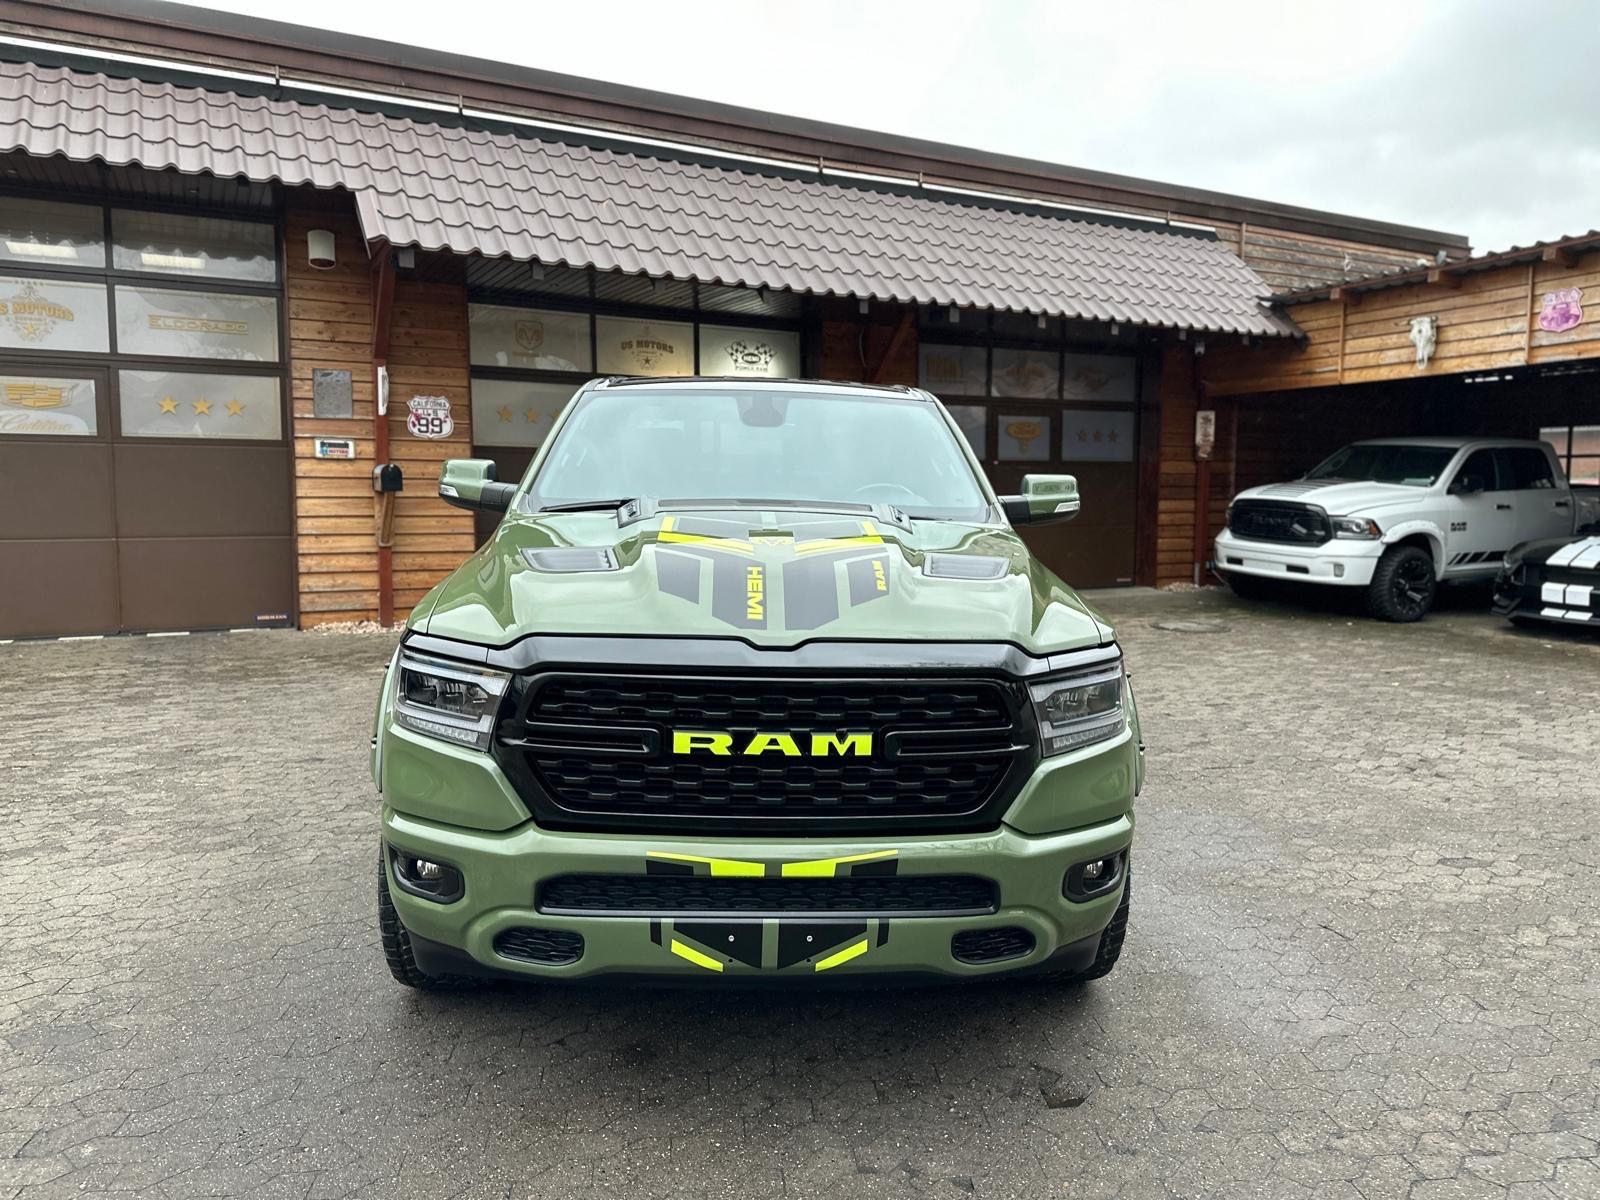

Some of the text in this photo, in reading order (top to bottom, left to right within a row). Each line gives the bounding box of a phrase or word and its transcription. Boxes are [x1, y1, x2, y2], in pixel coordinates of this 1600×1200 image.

[0, 303, 74, 321] S MOTORS
[620, 340, 674, 354] US MOTORS
[413, 400, 447, 408] CALIFORNIA
[417, 417, 443, 434] 99
[871, 560, 887, 591] RAM
[746, 566, 764, 621] HEMI
[672, 730, 873, 756] RAM
